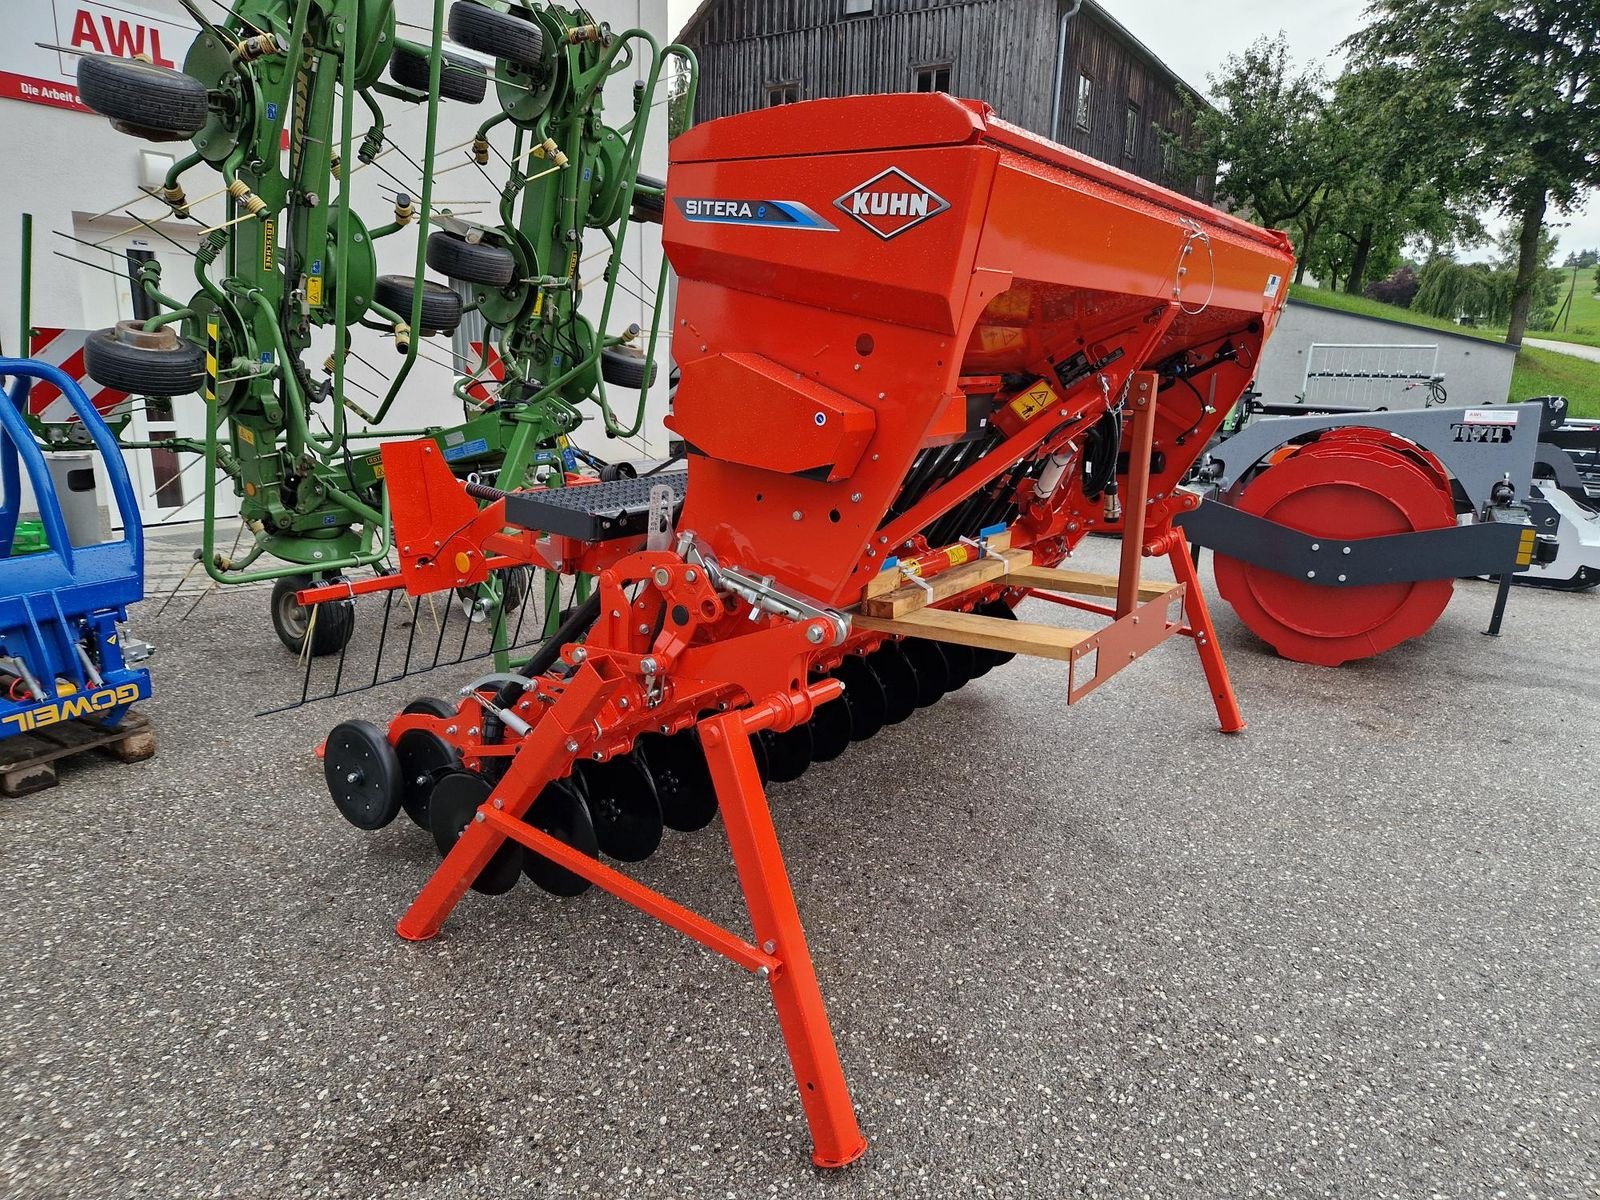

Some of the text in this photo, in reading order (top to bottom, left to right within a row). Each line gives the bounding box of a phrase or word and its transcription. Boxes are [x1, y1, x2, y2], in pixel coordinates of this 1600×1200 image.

[71, 9, 175, 69] AWL
[20, 82, 39, 96] Die
[41, 86, 74, 103] Arbeit
[685, 199, 766, 218] SITERA e
[851, 191, 929, 217] KUHN
